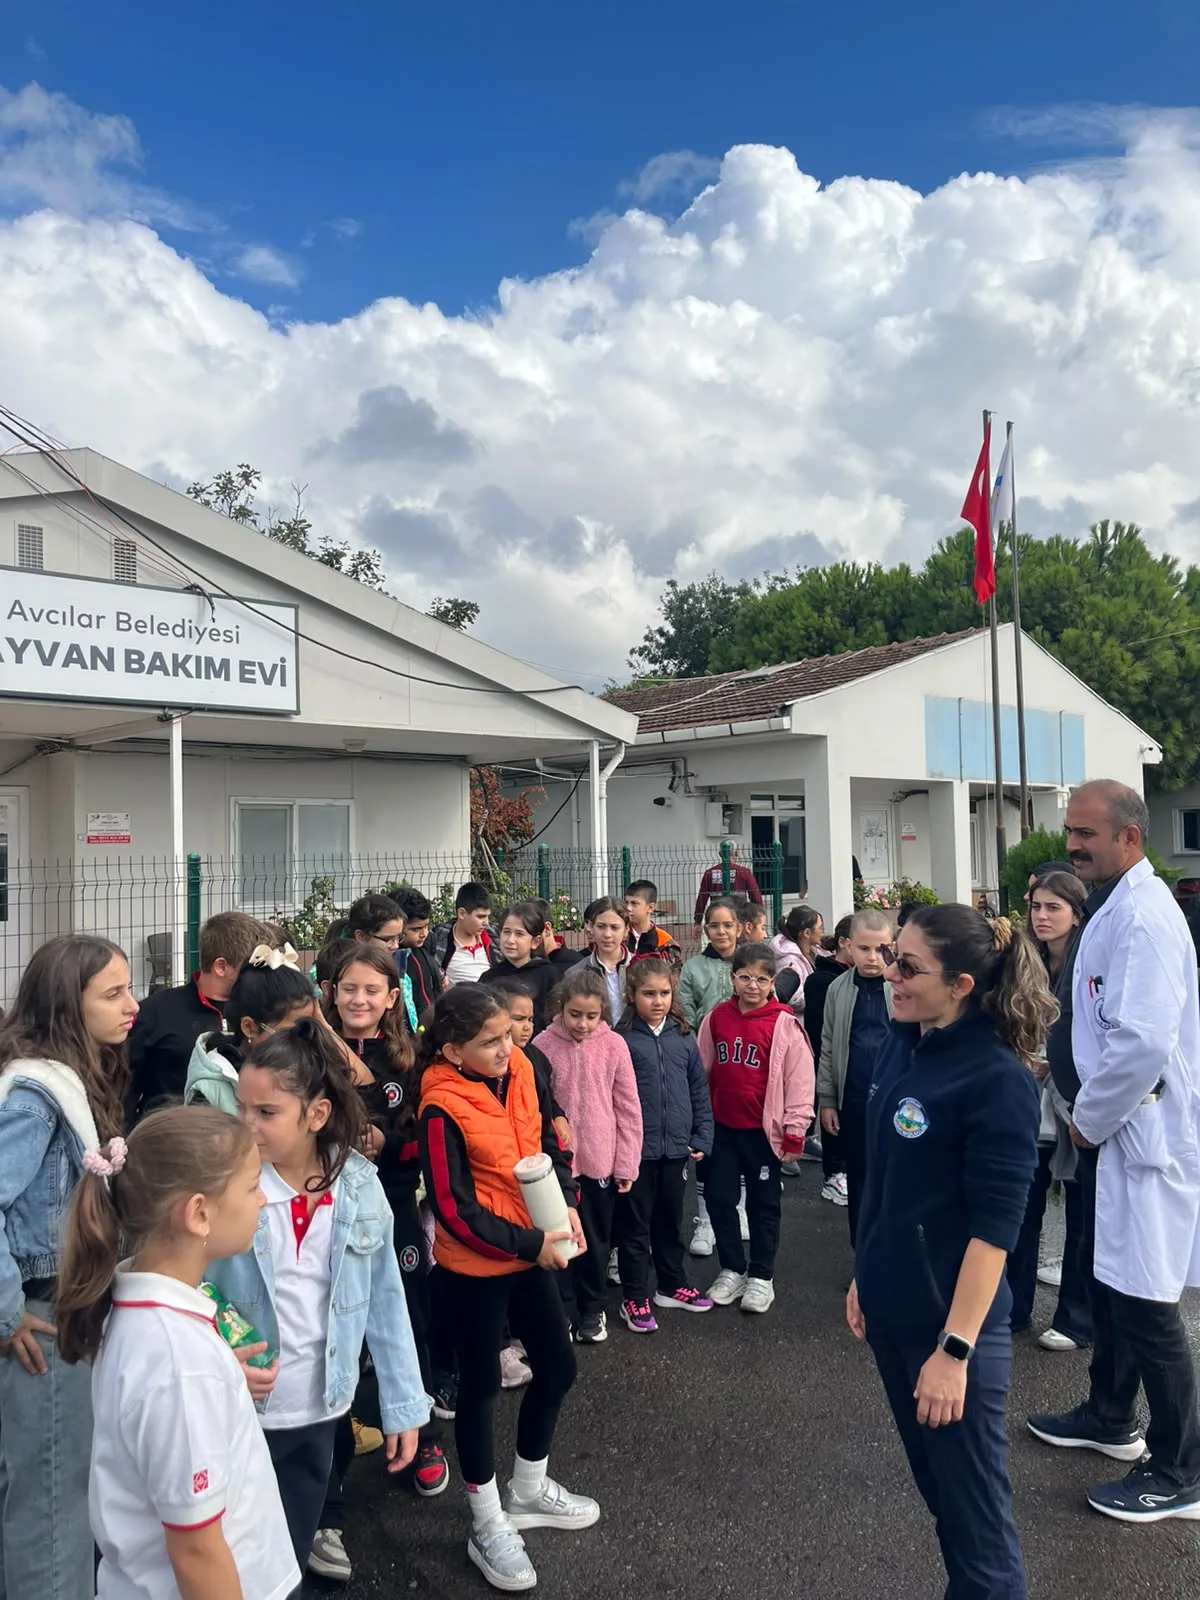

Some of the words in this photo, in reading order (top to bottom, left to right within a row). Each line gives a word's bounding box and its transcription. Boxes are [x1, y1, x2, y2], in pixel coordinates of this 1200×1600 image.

[7, 599, 106, 629] Avcılar
[116, 611, 240, 644] Belediyesi
[0, 637, 115, 672] YVAN
[124, 648, 230, 682] BAKIM
[239, 657, 287, 687] EVİ
[717, 1037, 760, 1068] BİL
